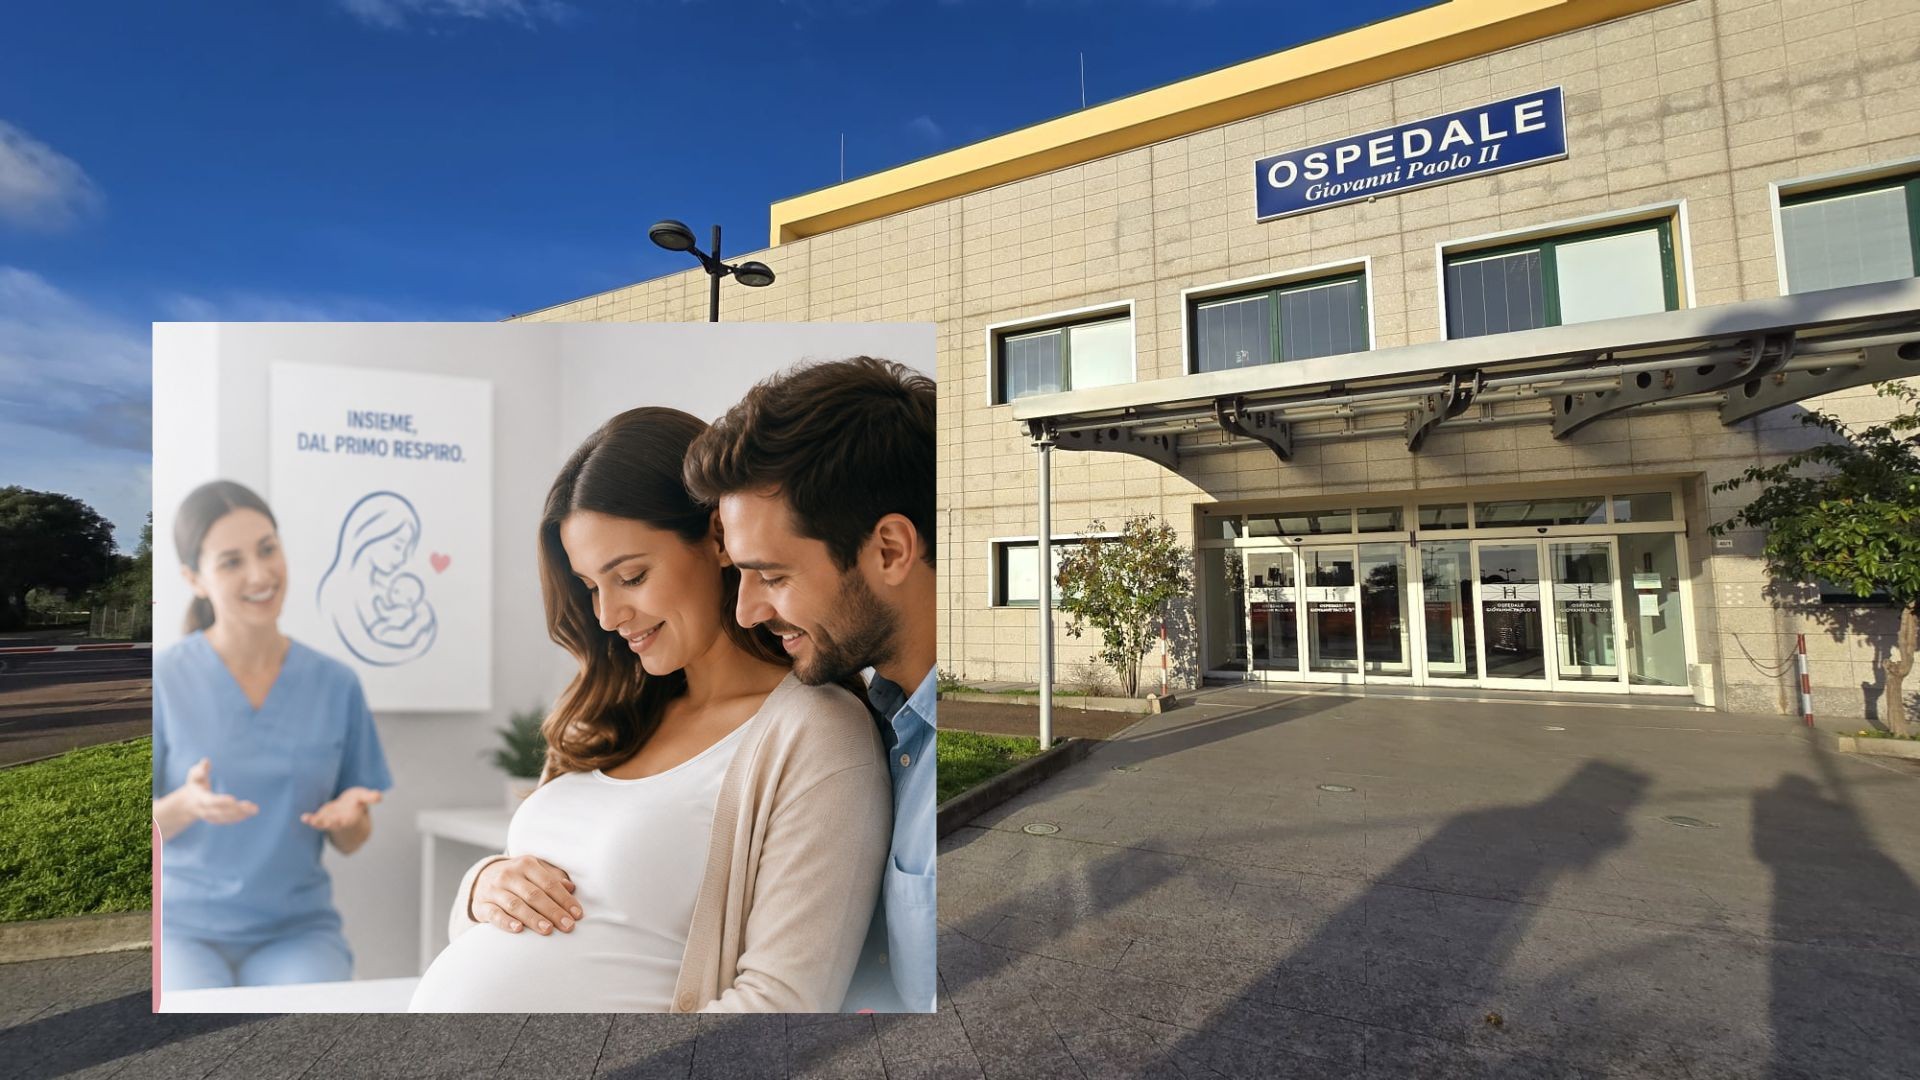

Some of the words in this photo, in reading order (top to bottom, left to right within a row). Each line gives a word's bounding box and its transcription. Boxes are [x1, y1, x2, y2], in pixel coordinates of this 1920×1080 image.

[1268, 99, 1546, 189] OSPEDALE
[1305, 167, 1401, 202] Giovanni
[1407, 152, 1471, 180] Paolo
[1477, 144, 1502, 165] II
[347, 410, 417, 435] INSIEME,
[297, 432, 329, 453] DAL
[335, 435, 388, 457] PRIMO
[393, 440, 466, 463] RESPIRO.
